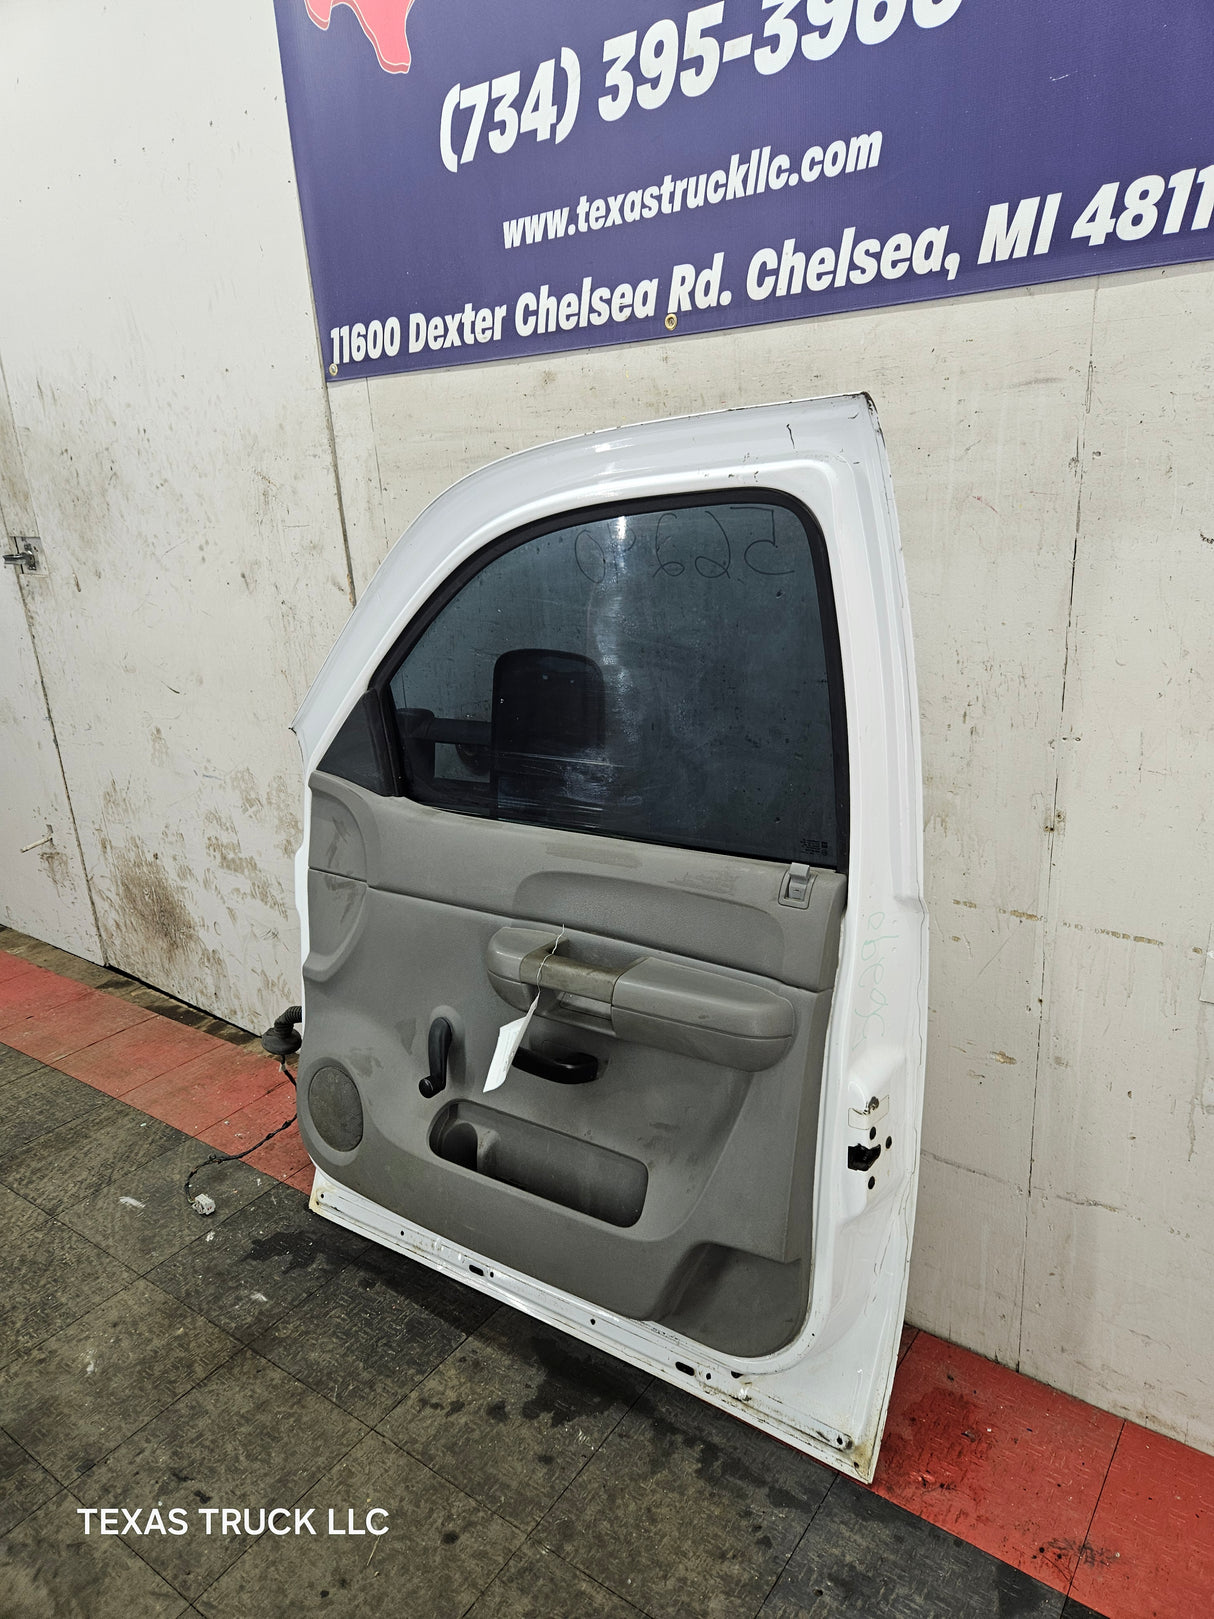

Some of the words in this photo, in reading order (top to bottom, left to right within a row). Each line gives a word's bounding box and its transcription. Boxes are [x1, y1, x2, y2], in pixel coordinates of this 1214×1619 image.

[440, 47, 580, 173] (734)
[598, 0, 962, 121] 395-39
[503, 130, 883, 249] www.texastruckllc.com
[331, 317, 400, 365] 11600
[409, 303, 507, 353] Dexter
[515, 277, 659, 337] Chelsea
[668, 252, 732, 314] Rd.
[746, 225, 960, 301] Chelsea,
[977, 192, 1063, 265] MI
